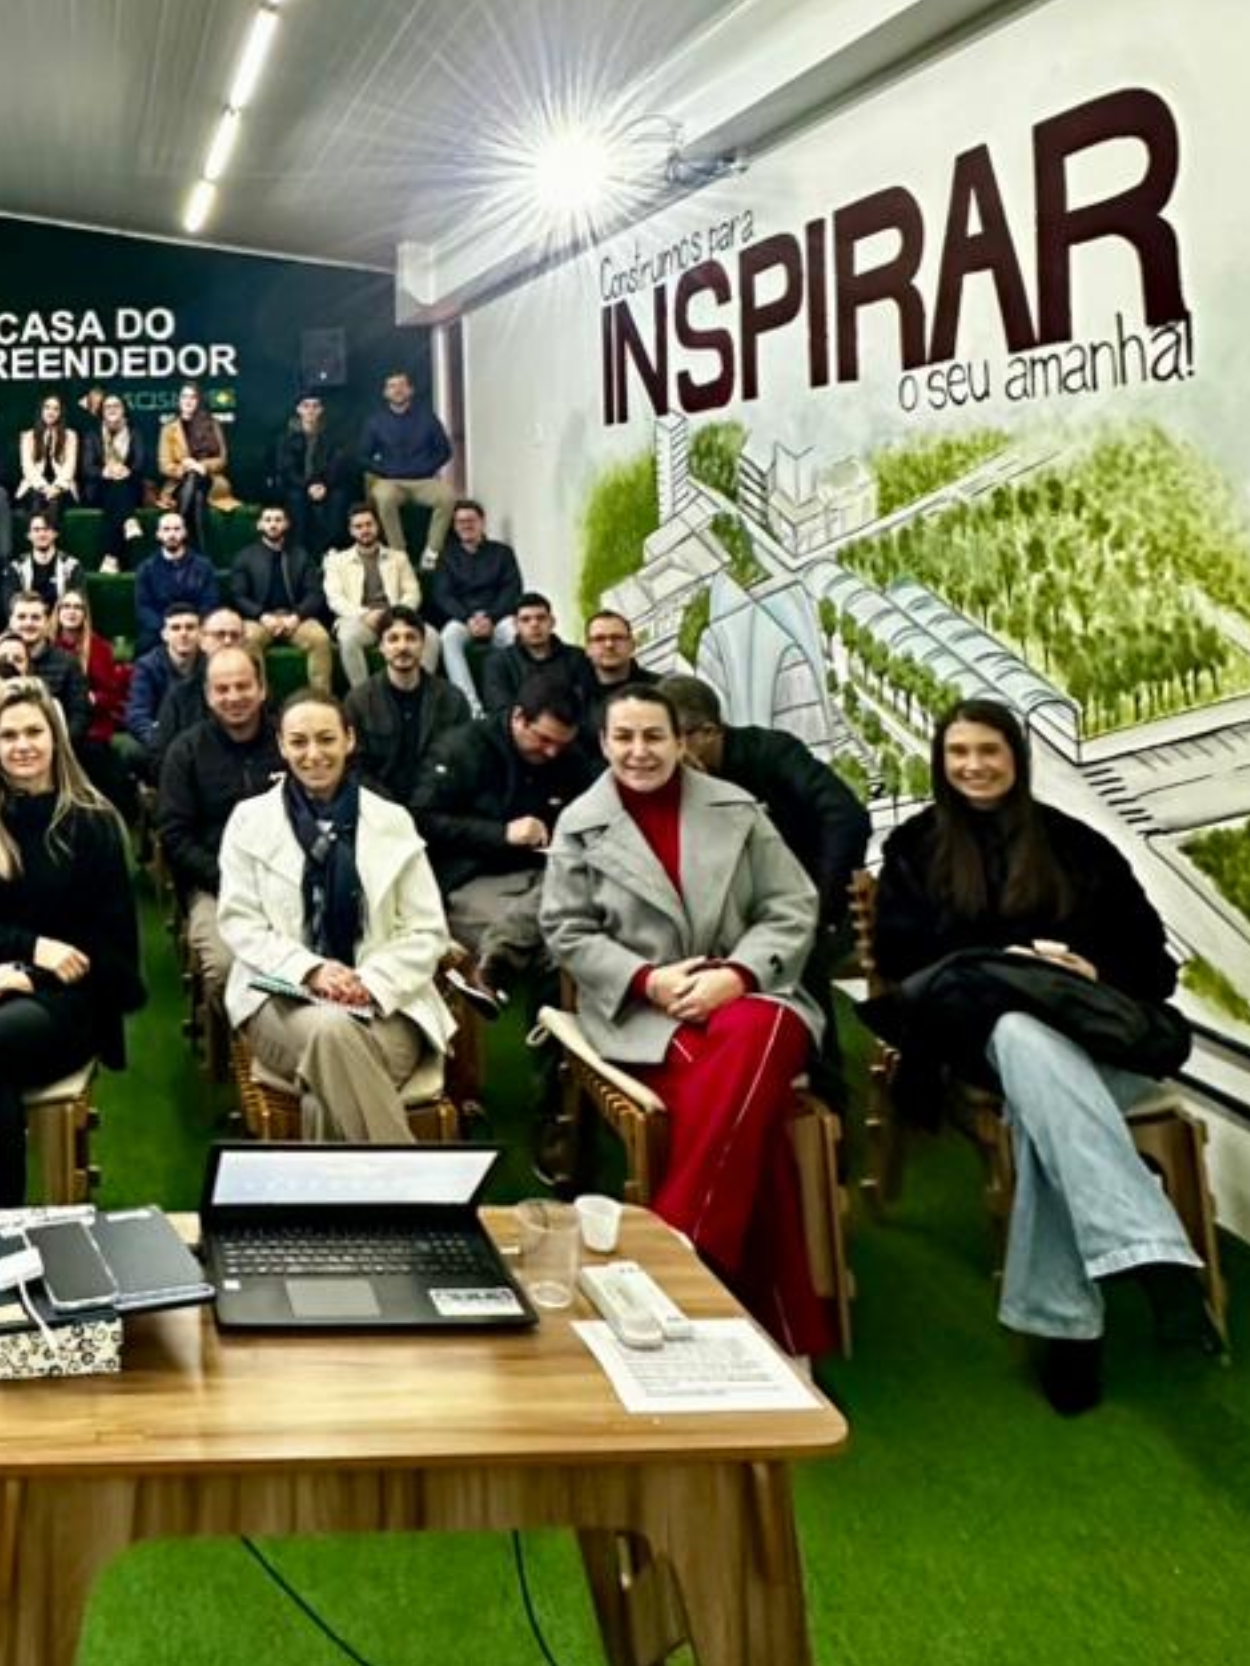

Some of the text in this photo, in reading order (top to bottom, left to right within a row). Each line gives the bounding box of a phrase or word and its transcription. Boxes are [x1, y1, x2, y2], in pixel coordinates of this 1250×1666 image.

[601, 87, 1186, 426] INSPIRAR
[115, 307, 176, 341] DO
[899, 374, 919, 412] o
[926, 360, 991, 411] seu
